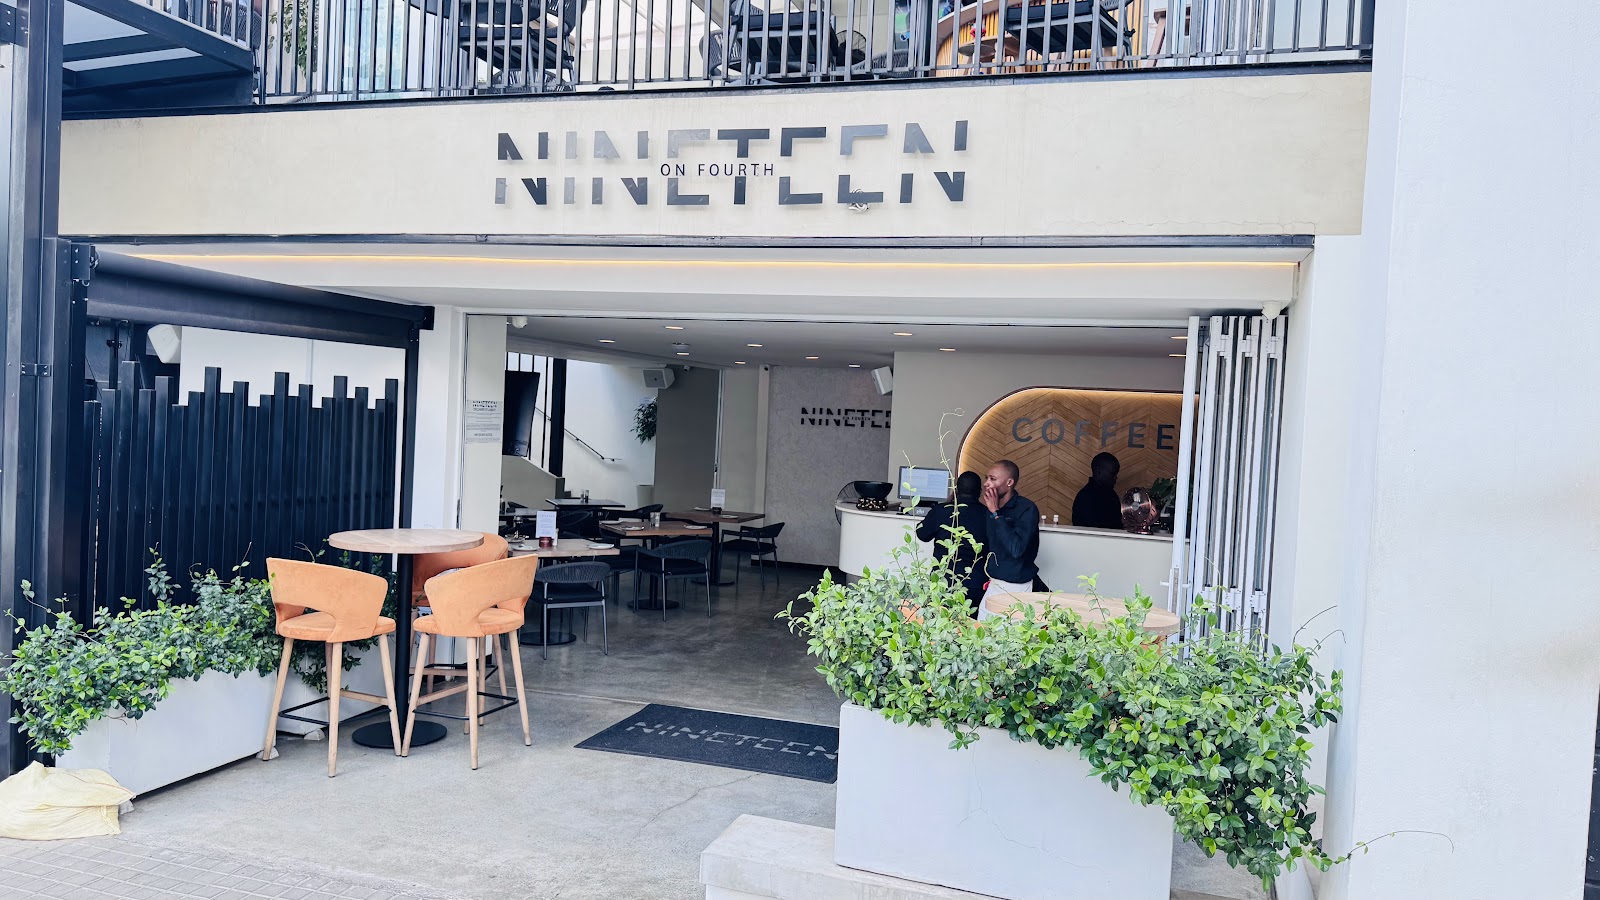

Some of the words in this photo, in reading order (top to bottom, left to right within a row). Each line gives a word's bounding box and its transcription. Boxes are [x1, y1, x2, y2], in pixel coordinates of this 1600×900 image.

[495, 120, 968, 206] NINETEEN
[660, 163, 685, 176] ON
[698, 163, 774, 176] FOURTH
[1012, 417, 1176, 450] COFFEE
